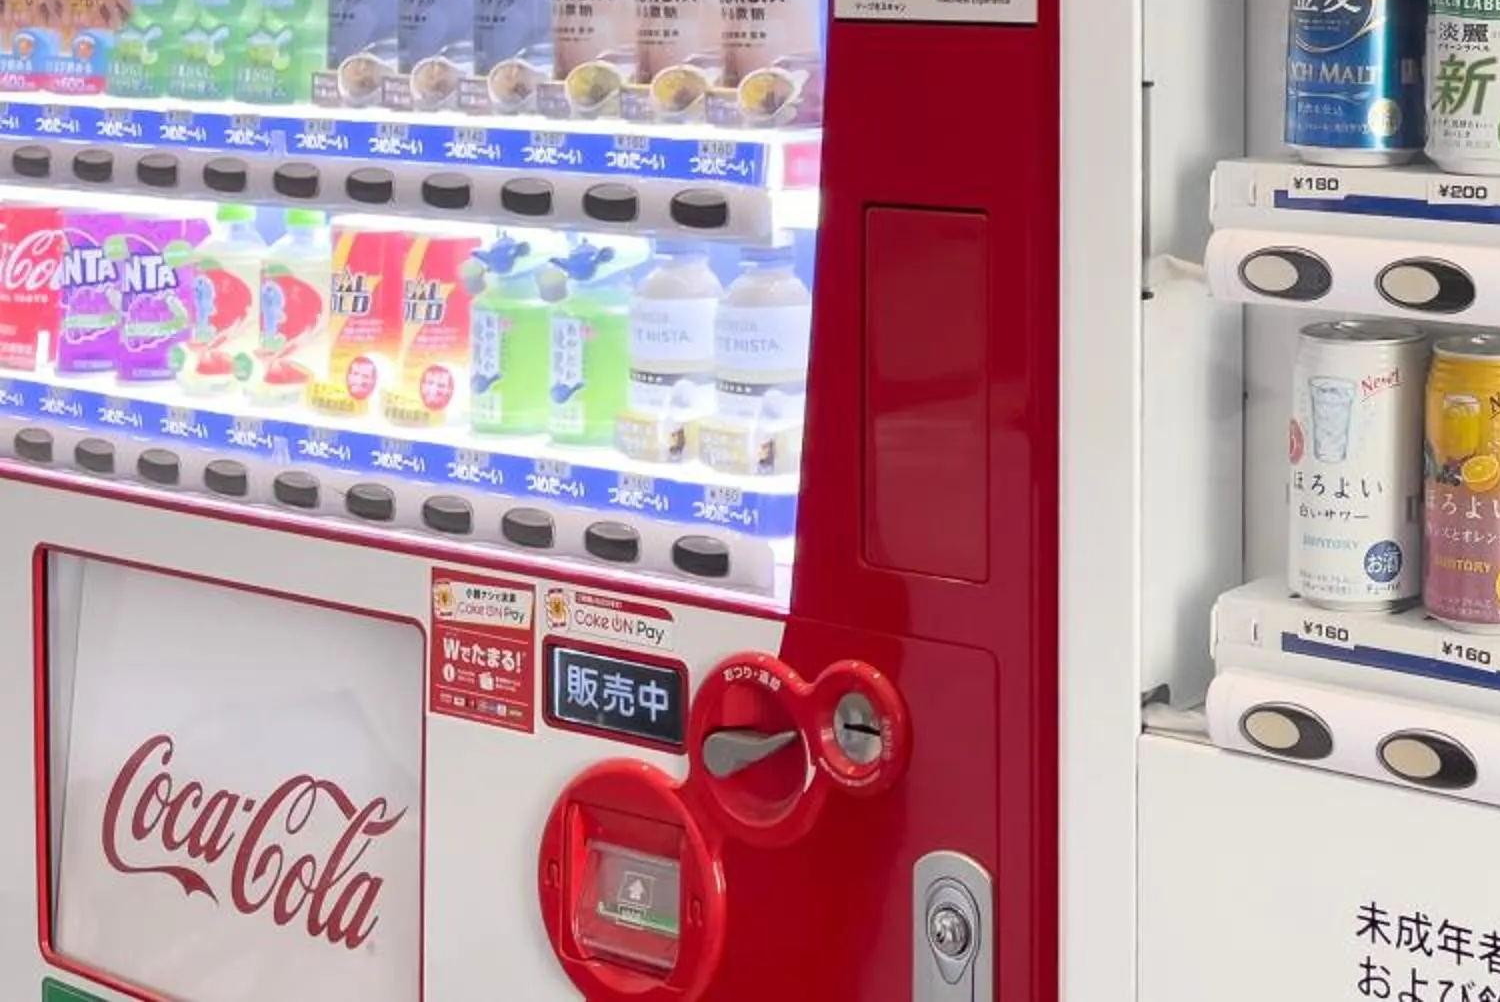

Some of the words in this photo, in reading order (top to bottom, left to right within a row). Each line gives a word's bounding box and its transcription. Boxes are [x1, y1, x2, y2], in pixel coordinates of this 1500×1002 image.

[1439, 21, 1489, 43] 淡麗
[1431, 53, 1499, 117] 新
[1294, 177, 1340, 192] ¥180
[1439, 184, 1488, 200] ¥200
[1294, 471, 1384, 500] ほろよい
[1299, 502, 1370, 521] 白いサワー
[574, 609, 609, 631] Coke
[612, 616, 634, 636] ON
[637, 624, 665, 644] Pay
[1302, 622, 1350, 642] ¥160
[1441, 639, 1492, 665] ¥160
[566, 665, 670, 722] 販売中
[102, 734, 408, 950] Coca-Cola
